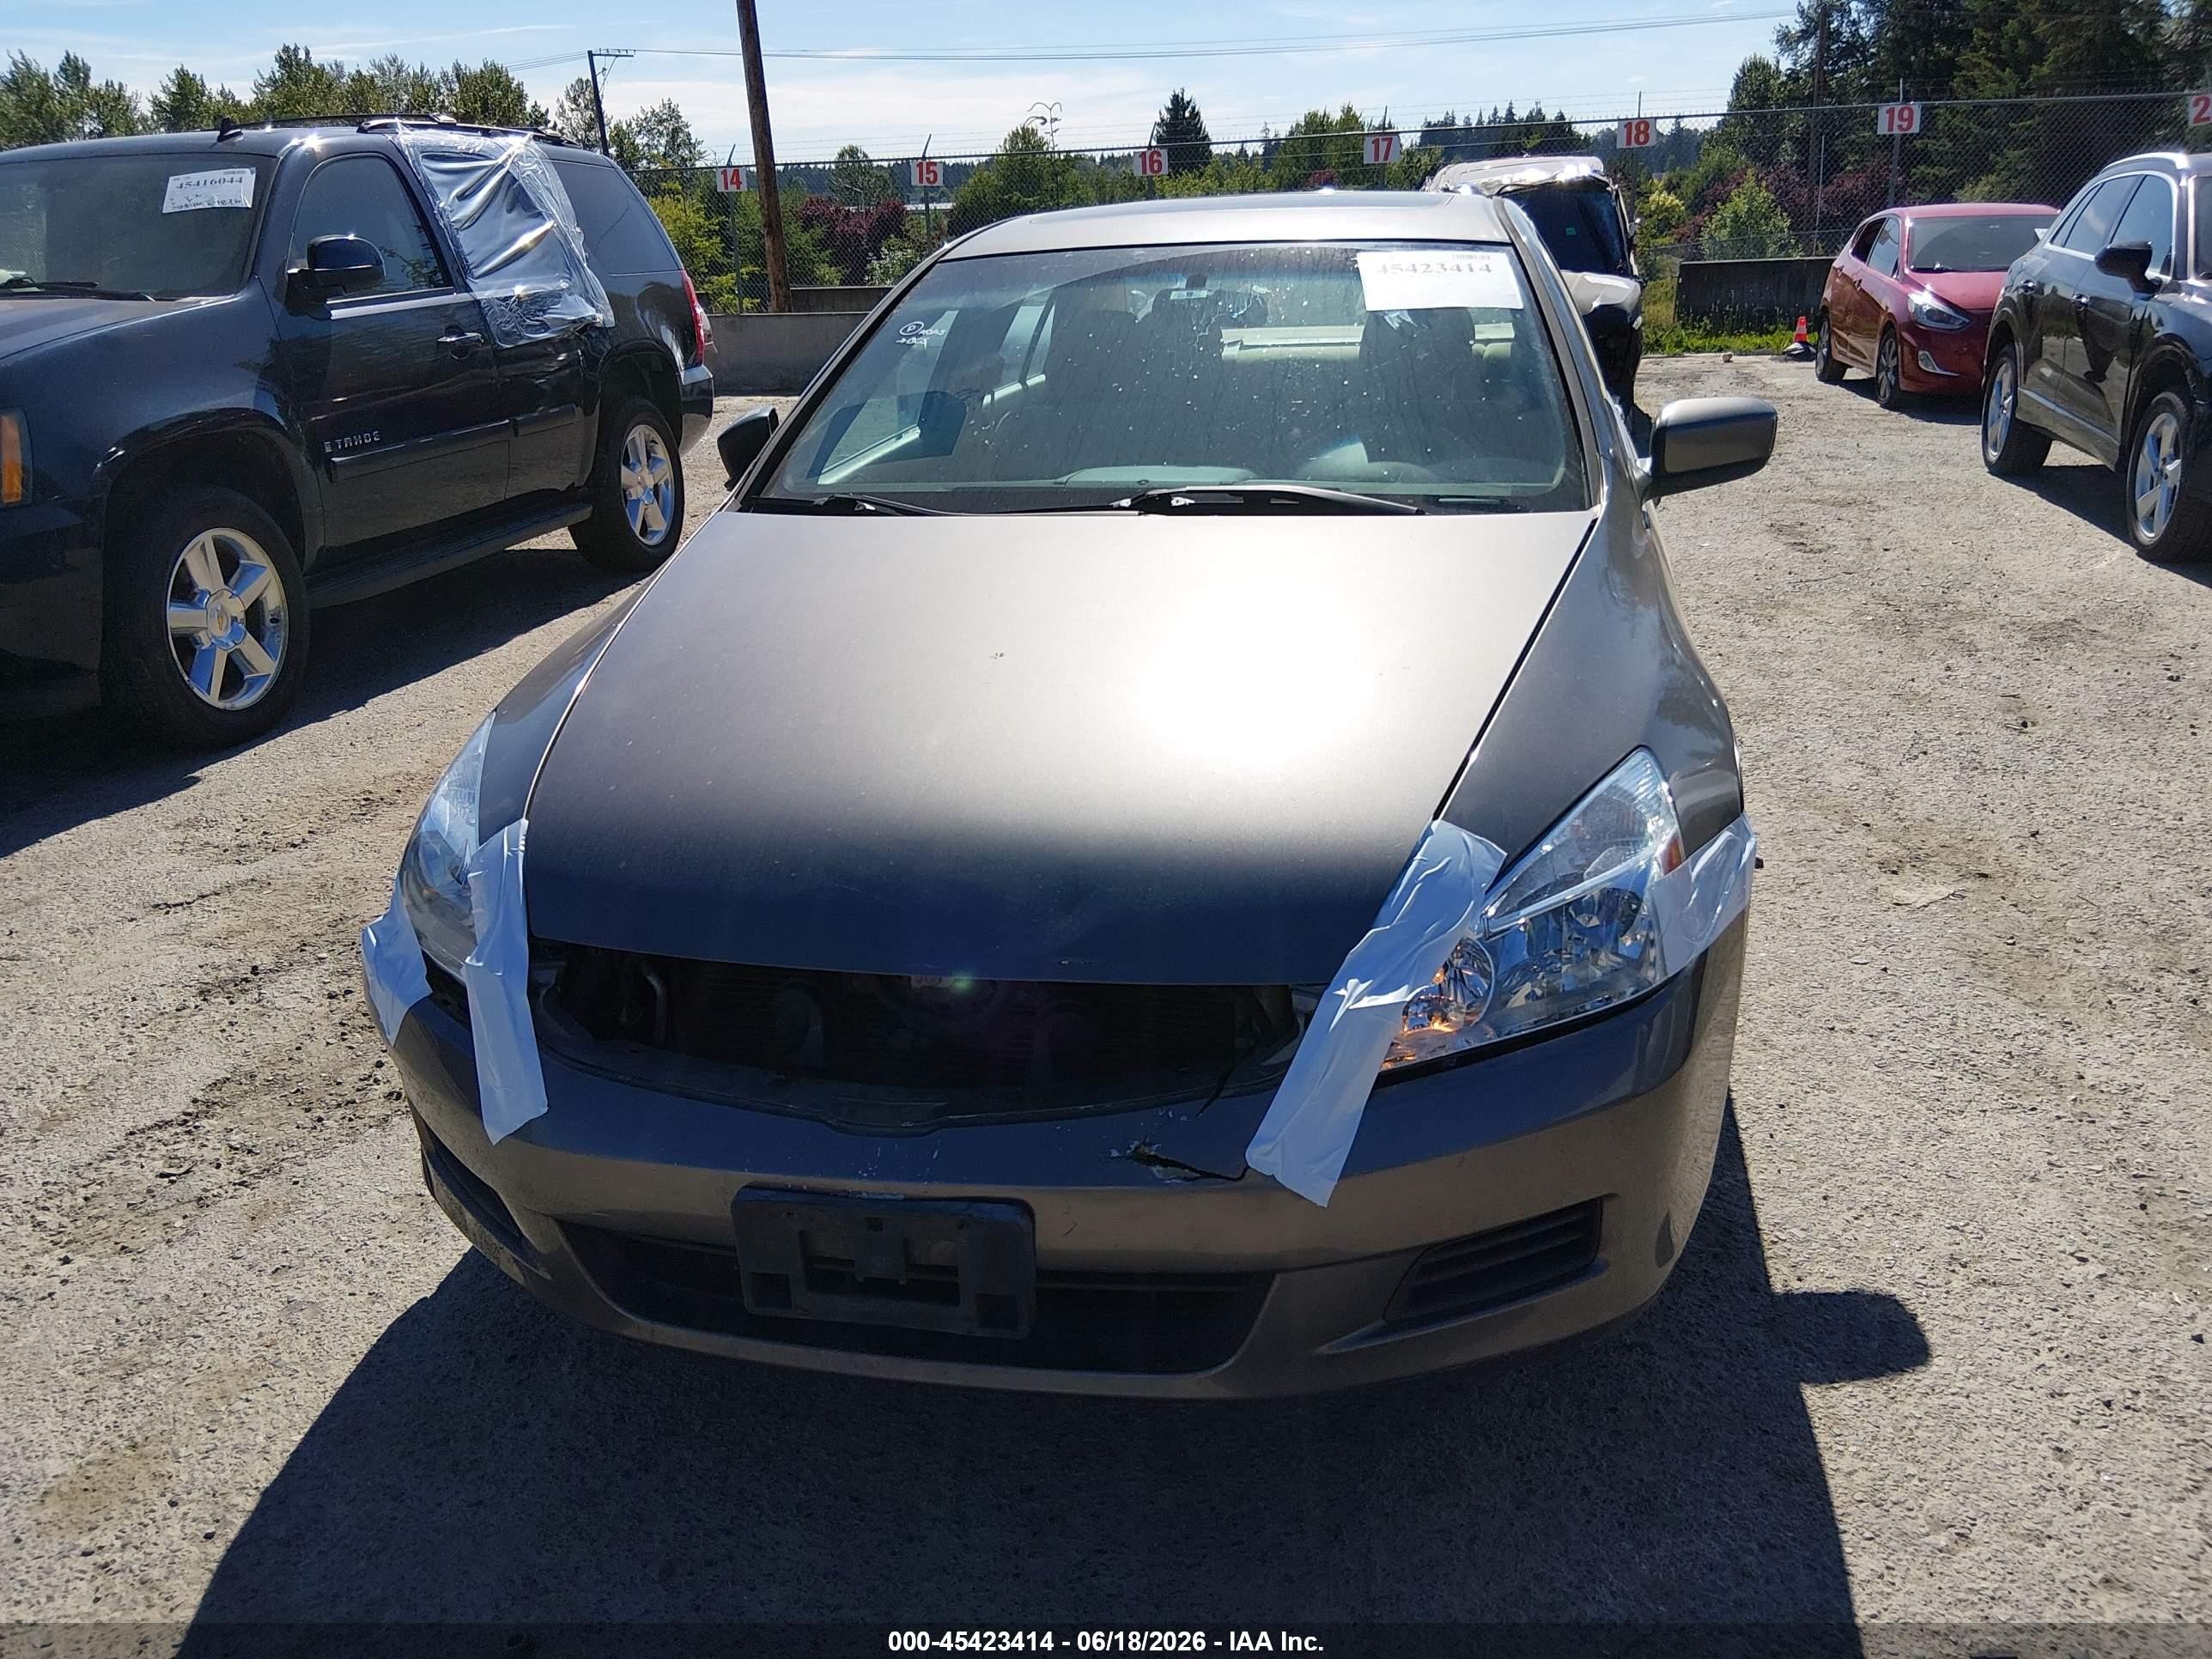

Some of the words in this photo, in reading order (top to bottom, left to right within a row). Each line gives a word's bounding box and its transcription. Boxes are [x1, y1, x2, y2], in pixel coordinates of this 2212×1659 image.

[1886, 106, 1915, 132] 19
[1624, 120, 1650, 146] 18
[1371, 137, 1393, 162] 17
[916, 161, 938, 185] 15
[1139, 150, 1163, 174] 16
[175, 176, 243, 190] 45416044
[721, 168, 743, 191] 14
[1376, 262, 1492, 275] 45423414
